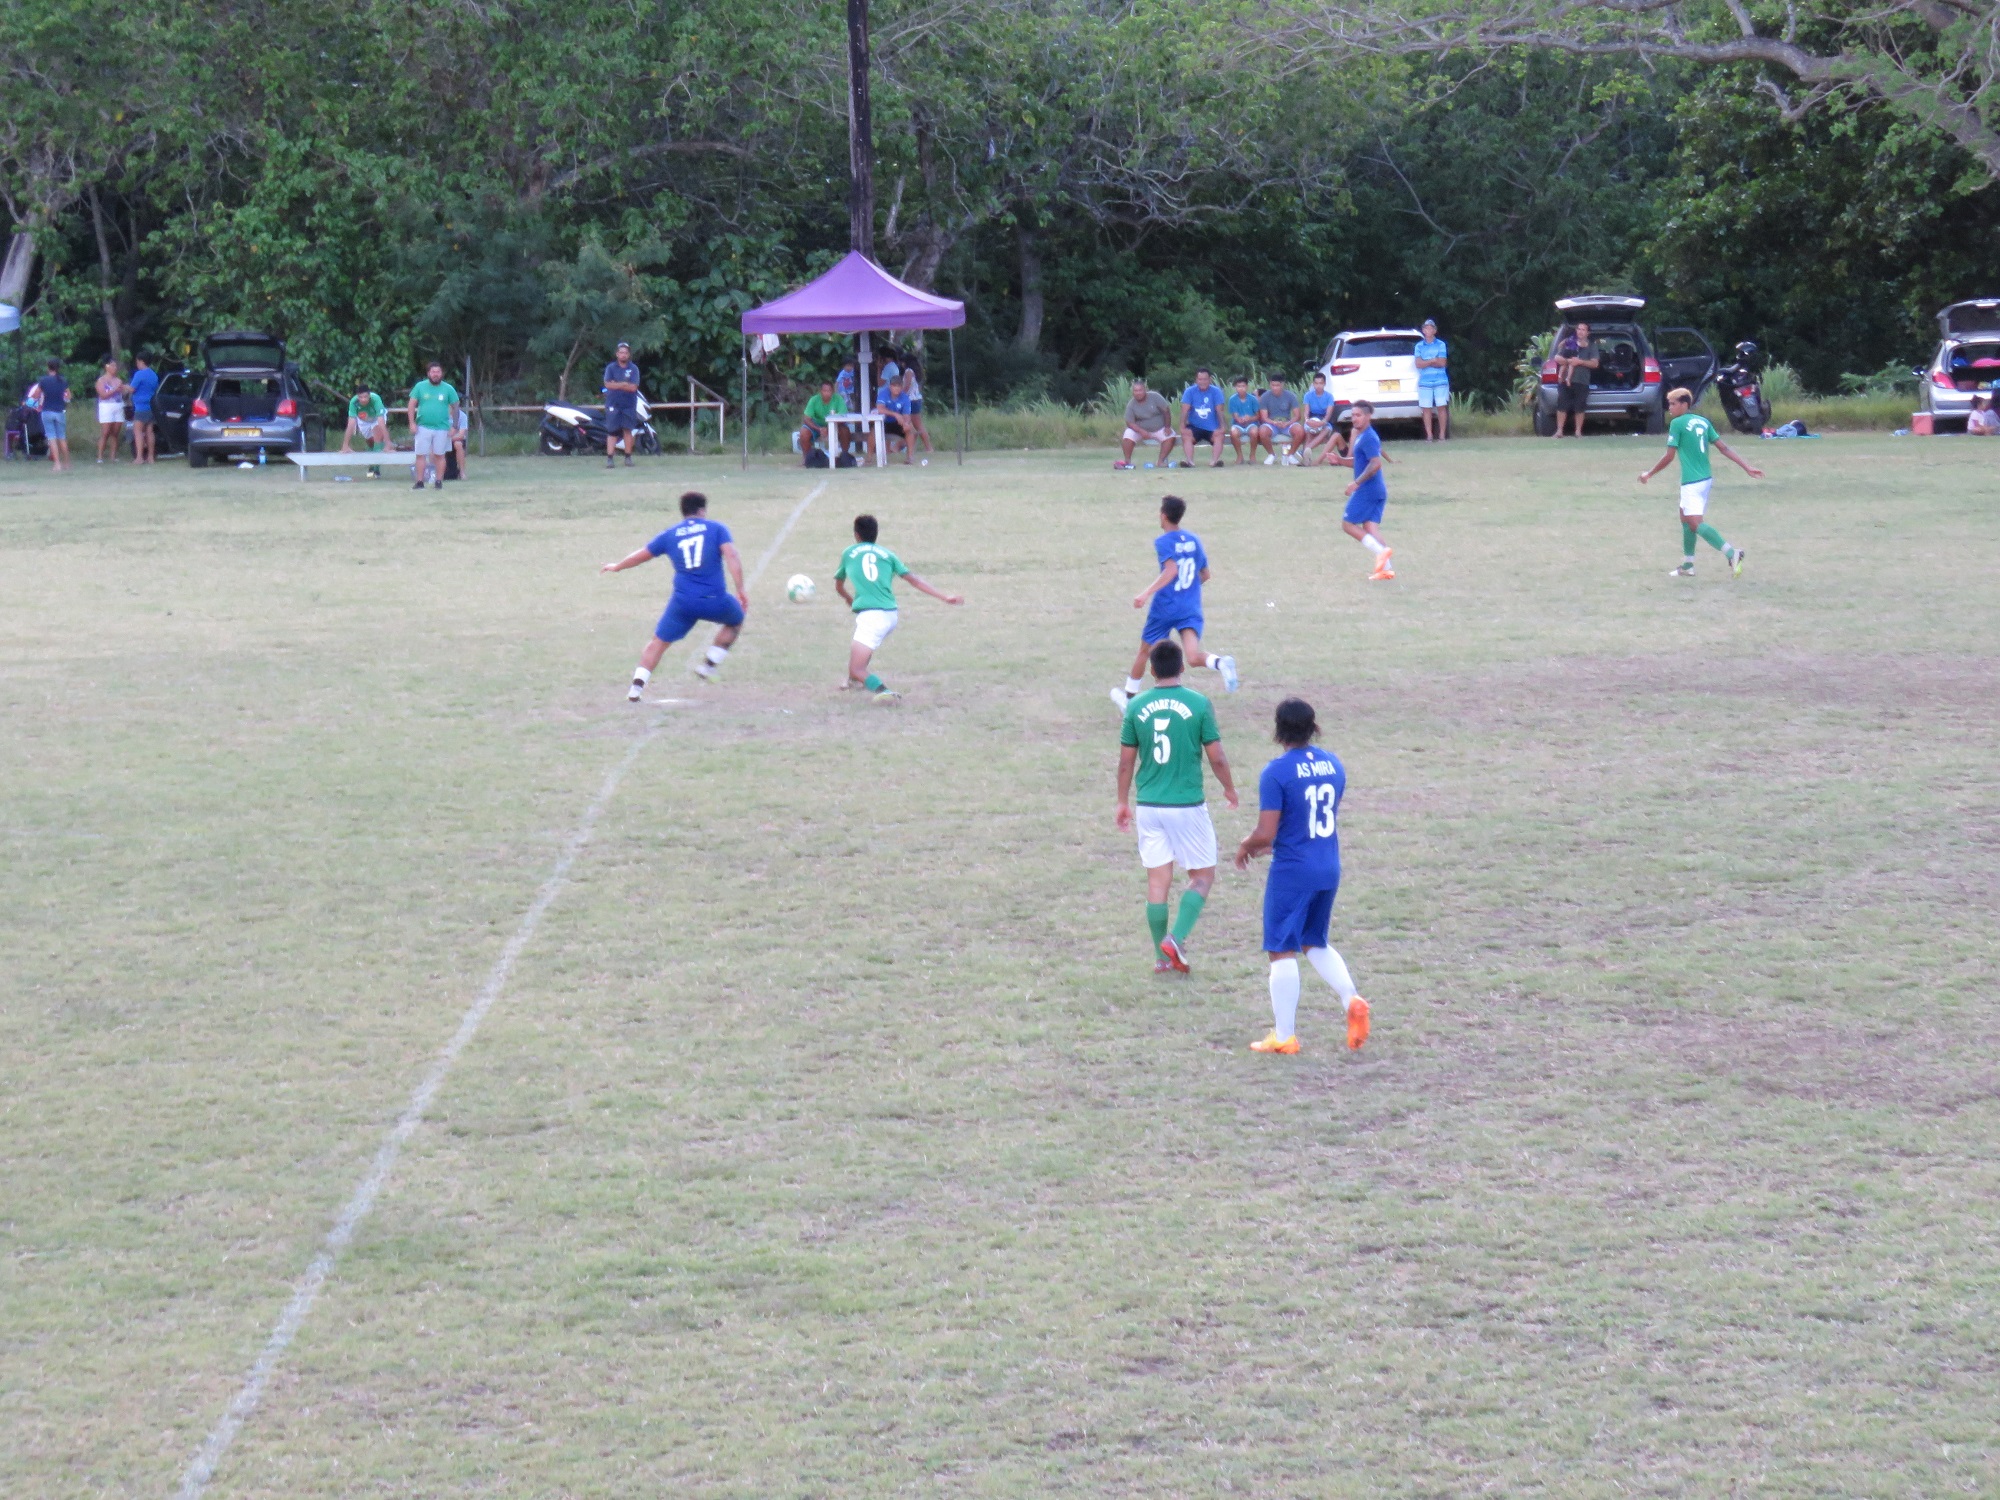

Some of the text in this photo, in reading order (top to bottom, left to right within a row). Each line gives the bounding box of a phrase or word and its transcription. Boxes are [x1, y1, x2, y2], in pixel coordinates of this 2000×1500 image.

[677, 534, 705, 569] 17
[861, 552, 879, 582] 6
[1174, 557, 1196, 591] 10
[1153, 717, 1171, 764] 5
[1296, 760, 1336, 778] AS MIRA
[1304, 783, 1335, 839] 13
